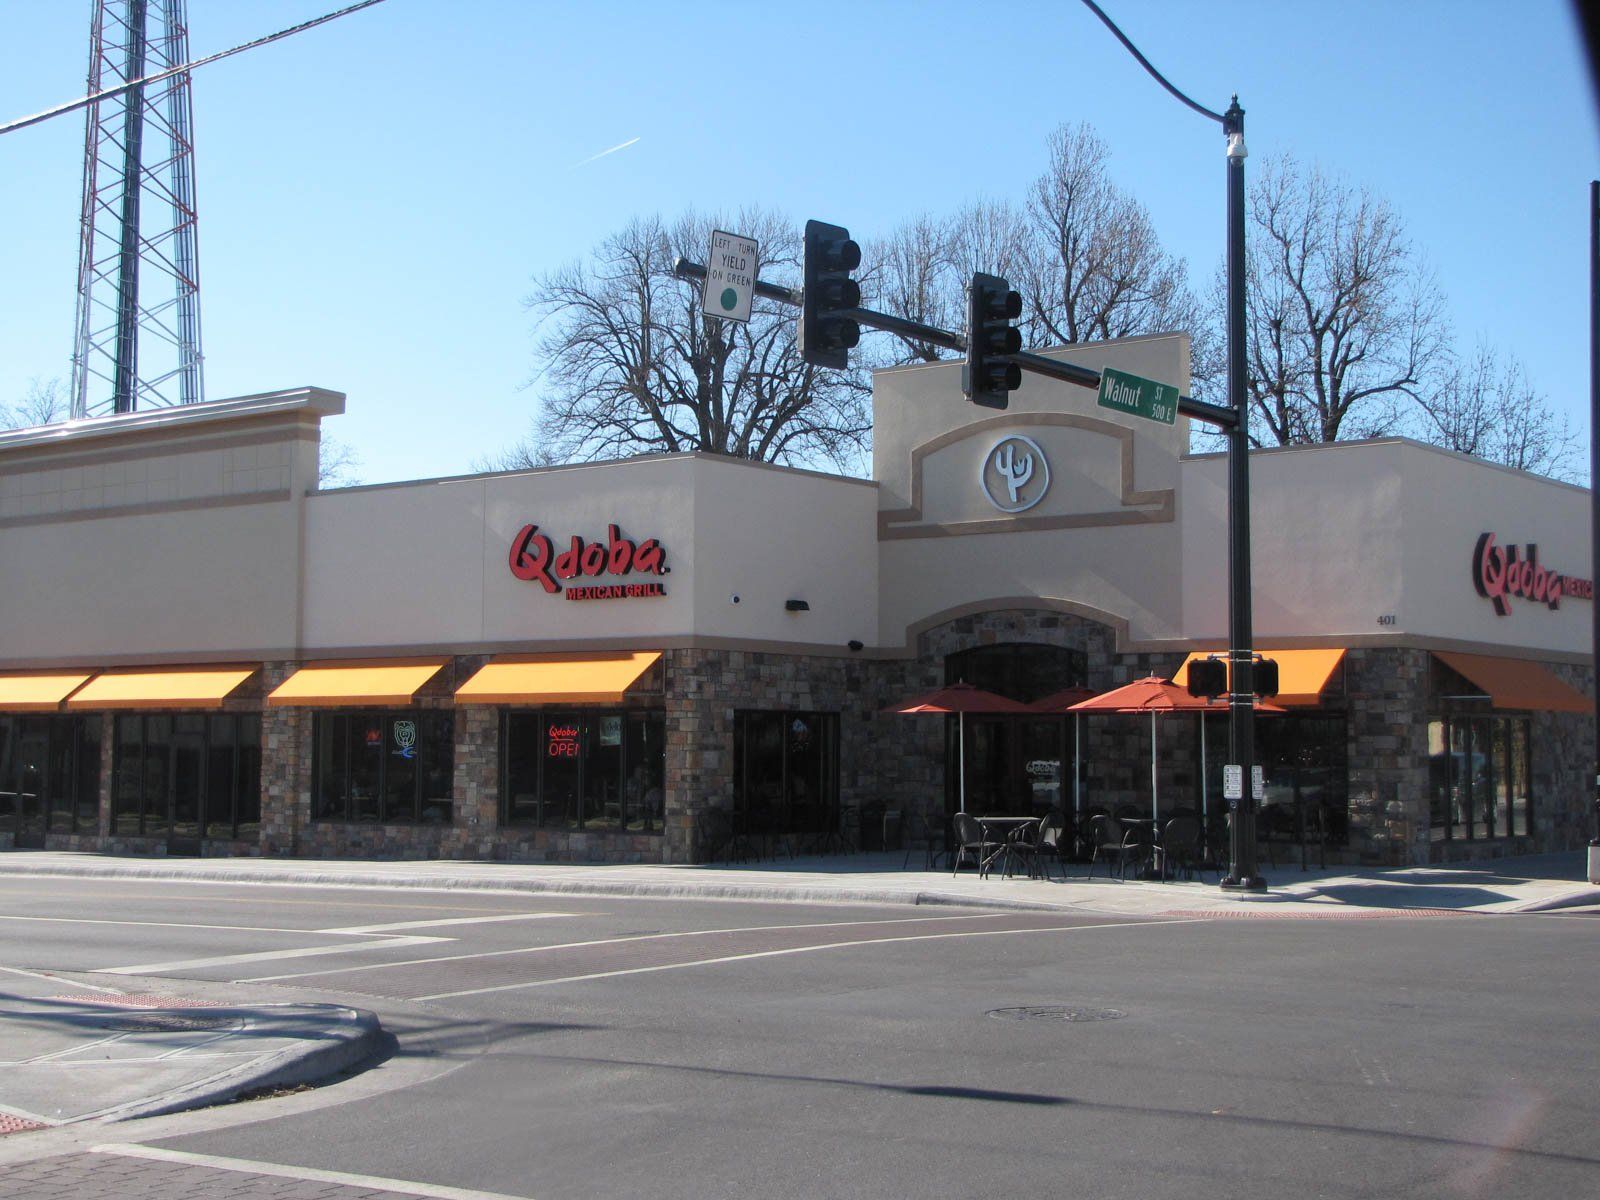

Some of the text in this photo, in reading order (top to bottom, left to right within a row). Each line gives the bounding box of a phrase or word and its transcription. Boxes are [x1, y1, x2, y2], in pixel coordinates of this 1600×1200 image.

[714, 238, 756, 256] LEFT TURN
[722, 254, 746, 271] YIELD
[712, 270, 751, 287] ON GREEN
[1104, 376, 1164, 408] Walnut ST
[1151, 403, 1172, 421] 500 E
[509, 524, 667, 593] Qdoba
[1472, 532, 1561, 616] Qdoba
[566, 582, 664, 600] MEXICAN GRILL
[1376, 615, 1396, 626] 401
